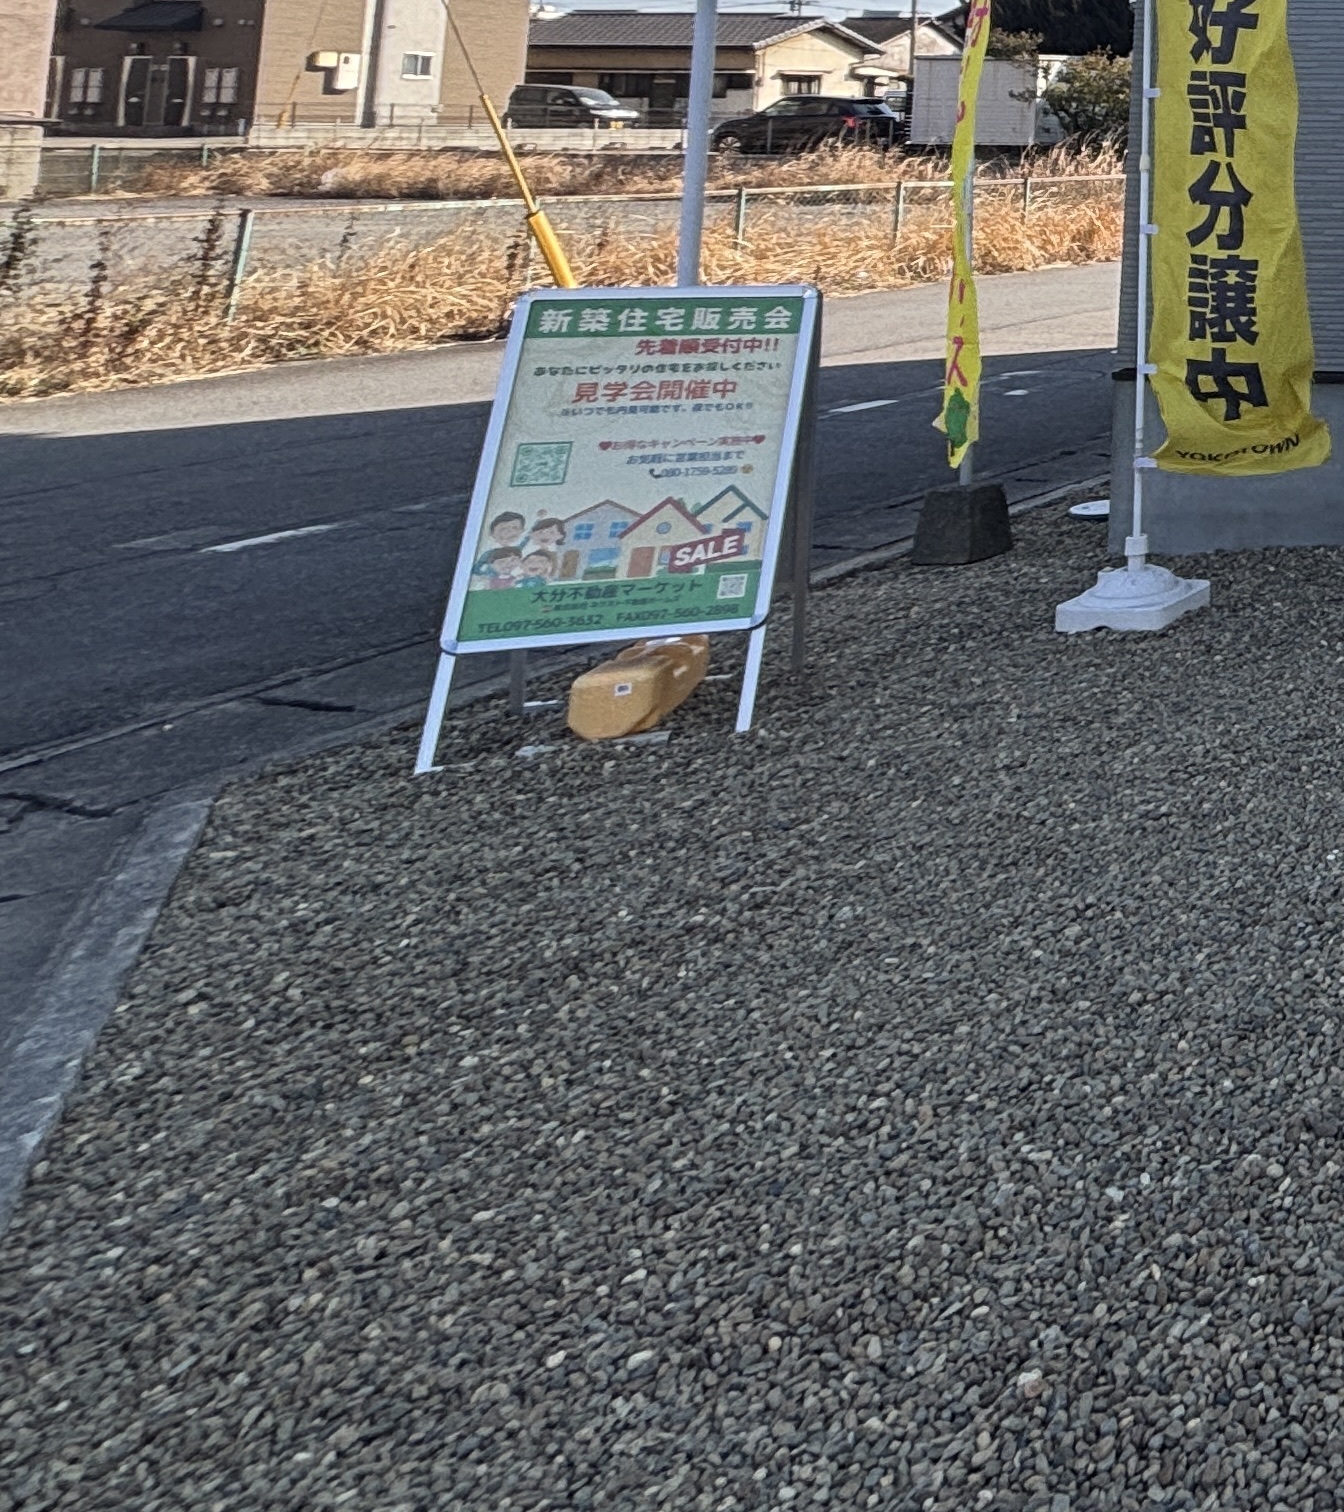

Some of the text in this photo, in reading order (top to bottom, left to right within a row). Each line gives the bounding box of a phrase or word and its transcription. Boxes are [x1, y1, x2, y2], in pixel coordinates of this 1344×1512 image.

[538, 306, 793, 334] 新築住宅販売会
[571, 378, 738, 404] 見学会開催中
[672, 535, 739, 568] SALE
[530, 578, 703, 603] 大分不動産マーケット
